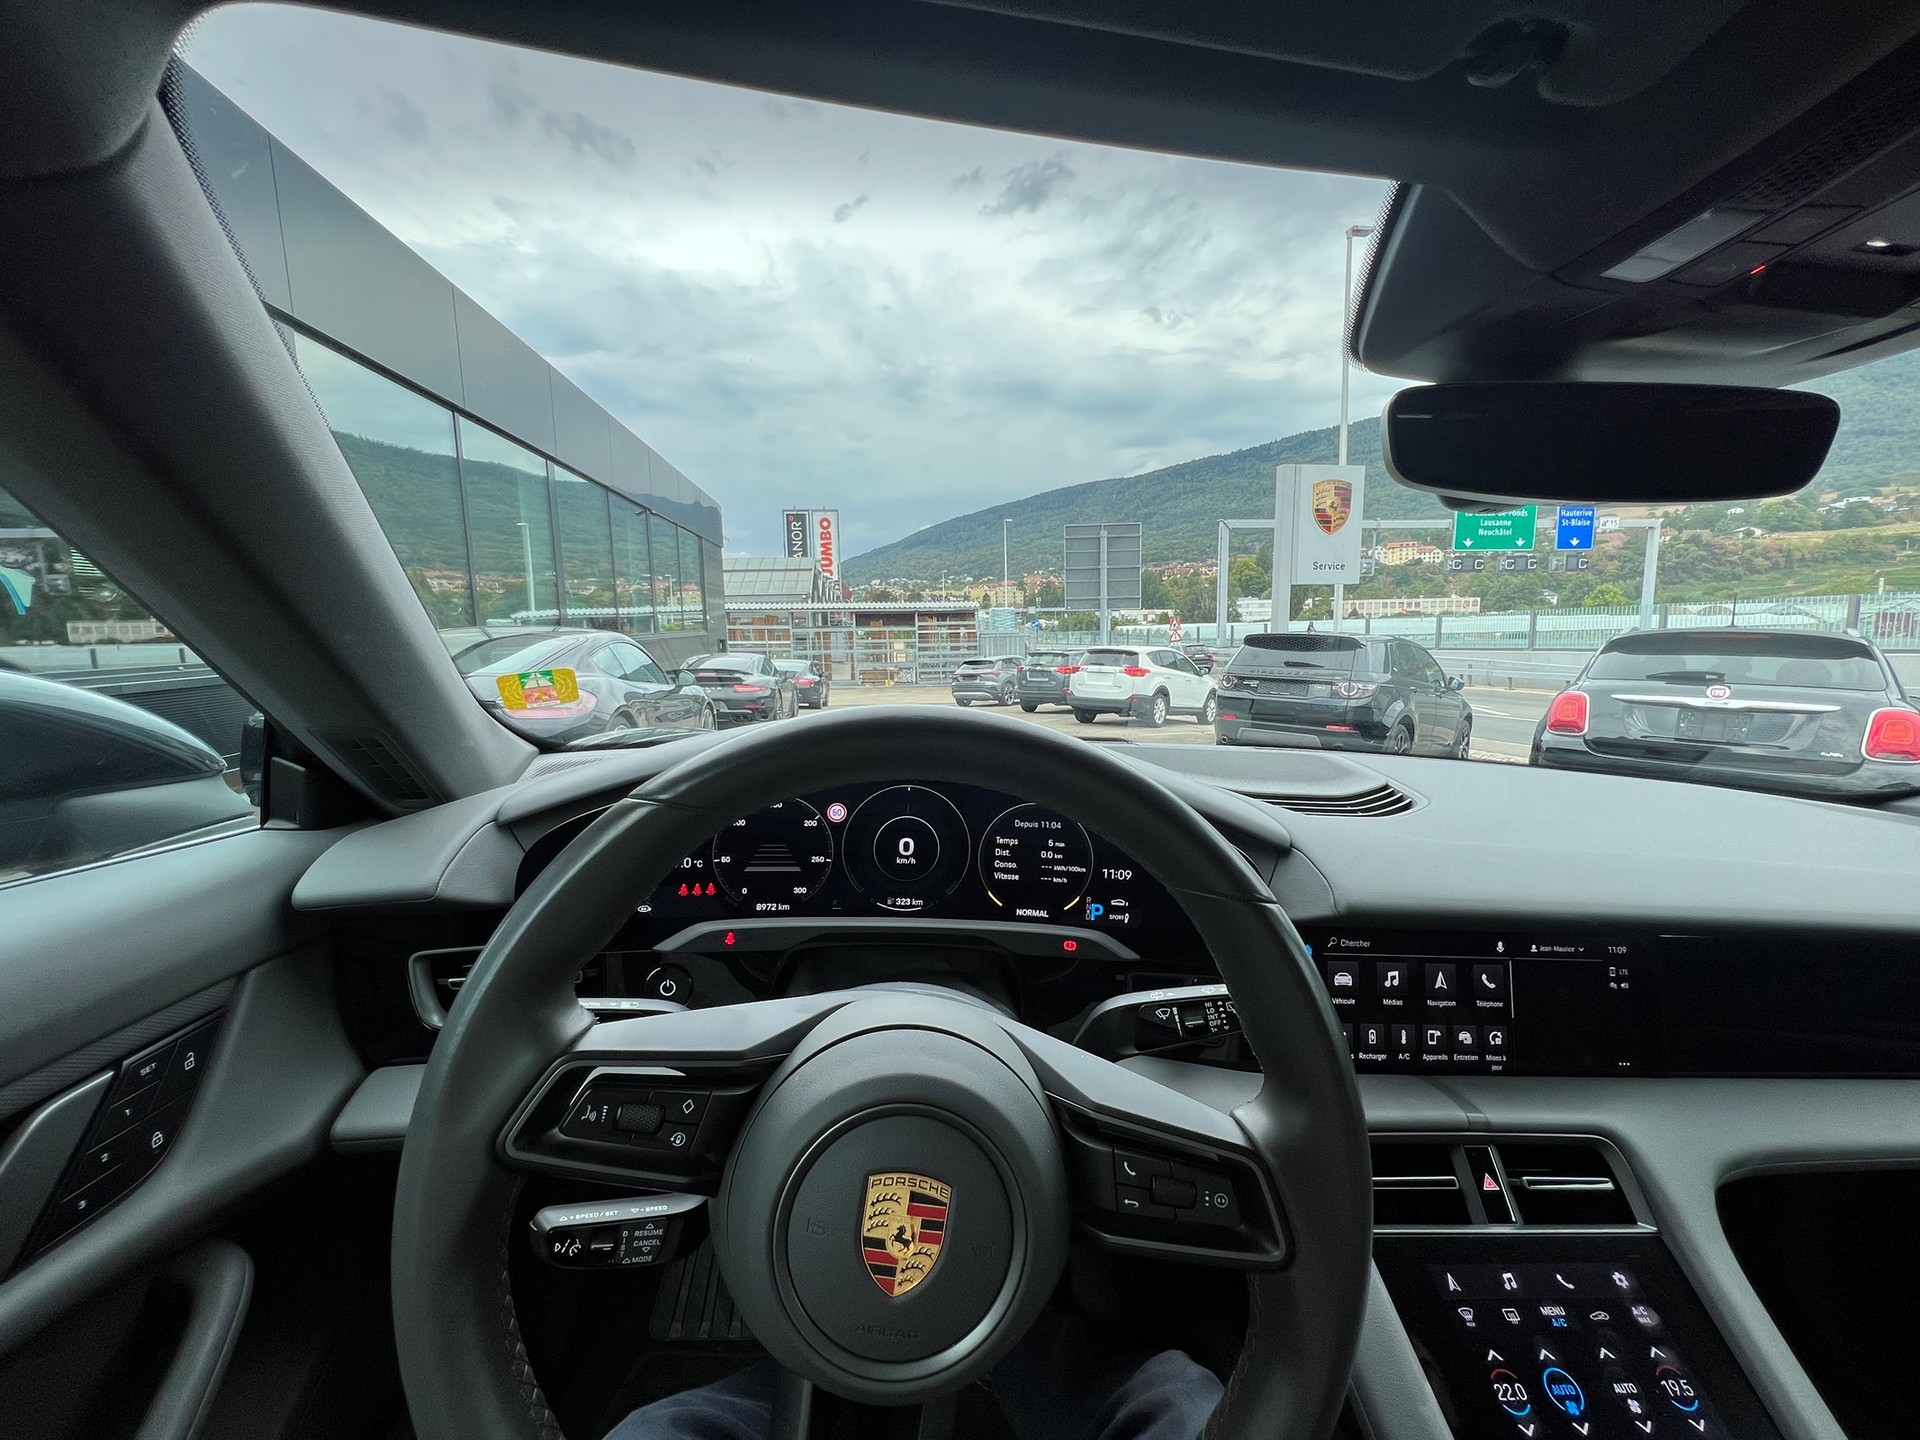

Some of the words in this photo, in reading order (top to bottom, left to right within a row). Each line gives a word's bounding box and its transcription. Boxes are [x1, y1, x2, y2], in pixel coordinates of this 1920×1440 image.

[1560, 509, 1593, 517] Hauterive
[1480, 518, 1512, 527] Lausanne
[1561, 518, 1591, 527] St-Blaise
[1609, 519, 1618, 527] 15
[1478, 528, 1513, 537] Neuchâtel
[791, 520, 803, 558] ANOR
[819, 517, 834, 577] JUMBO
[1312, 561, 1346, 571] Service
[832, 808, 843, 817] 50
[803, 819, 818, 827] 200
[1014, 819, 1039, 829] Depuis
[1040, 820, 1062, 829] 11:04
[996, 836, 1019, 847] Temps
[898, 837, 915, 856] 0
[995, 848, 1011, 857] Dist.
[1040, 851, 1054, 859] 0.0
[896, 857, 916, 865] km/h
[994, 860, 1018, 869] Conso.
[993, 871, 1020, 881] Vitesse
[1102, 868, 1133, 880] 11:09
[741, 887, 748, 895] 0
[895, 897, 911, 906] 323
[911, 898, 924, 906] km
[755, 902, 777, 911] 8972
[777, 903, 790, 911] km
[1015, 908, 1050, 918] NORMAL
[1090, 903, 1104, 921] P
[1340, 938, 1371, 948] Chercher
[1539, 945, 1575, 953] Jean-Maurice
[1607, 946, 1628, 954] 11:09
[1382, 998, 1403, 1006] Médias
[1426, 999, 1457, 1008] Navigation
[1476, 1000, 1504, 1009] Téléphone
[1358, 1052, 1387, 1061] Recharger
[1422, 1053, 1449, 1062] Appareils
[1453, 1053, 1479, 1061] Entretien
[139, 1062, 157, 1076] SET
[100, 1152, 110, 1163] 2
[871, 1176, 949, 1197] PORSCHE
[77, 1200, 87, 1210] 3
[634, 1228, 664, 1237] RESUME
[633, 1238, 661, 1248] CANCEL
[631, 1255, 653, 1263] MODE
[1539, 1306, 1566, 1316] MENU
[1551, 1318, 1568, 1327] A/C
[1493, 1383, 1527, 1401] 22.0
[1551, 1384, 1576, 1396] AUTO
[1613, 1383, 1638, 1394] AUTO
[1661, 1379, 1694, 1397] 19.5
